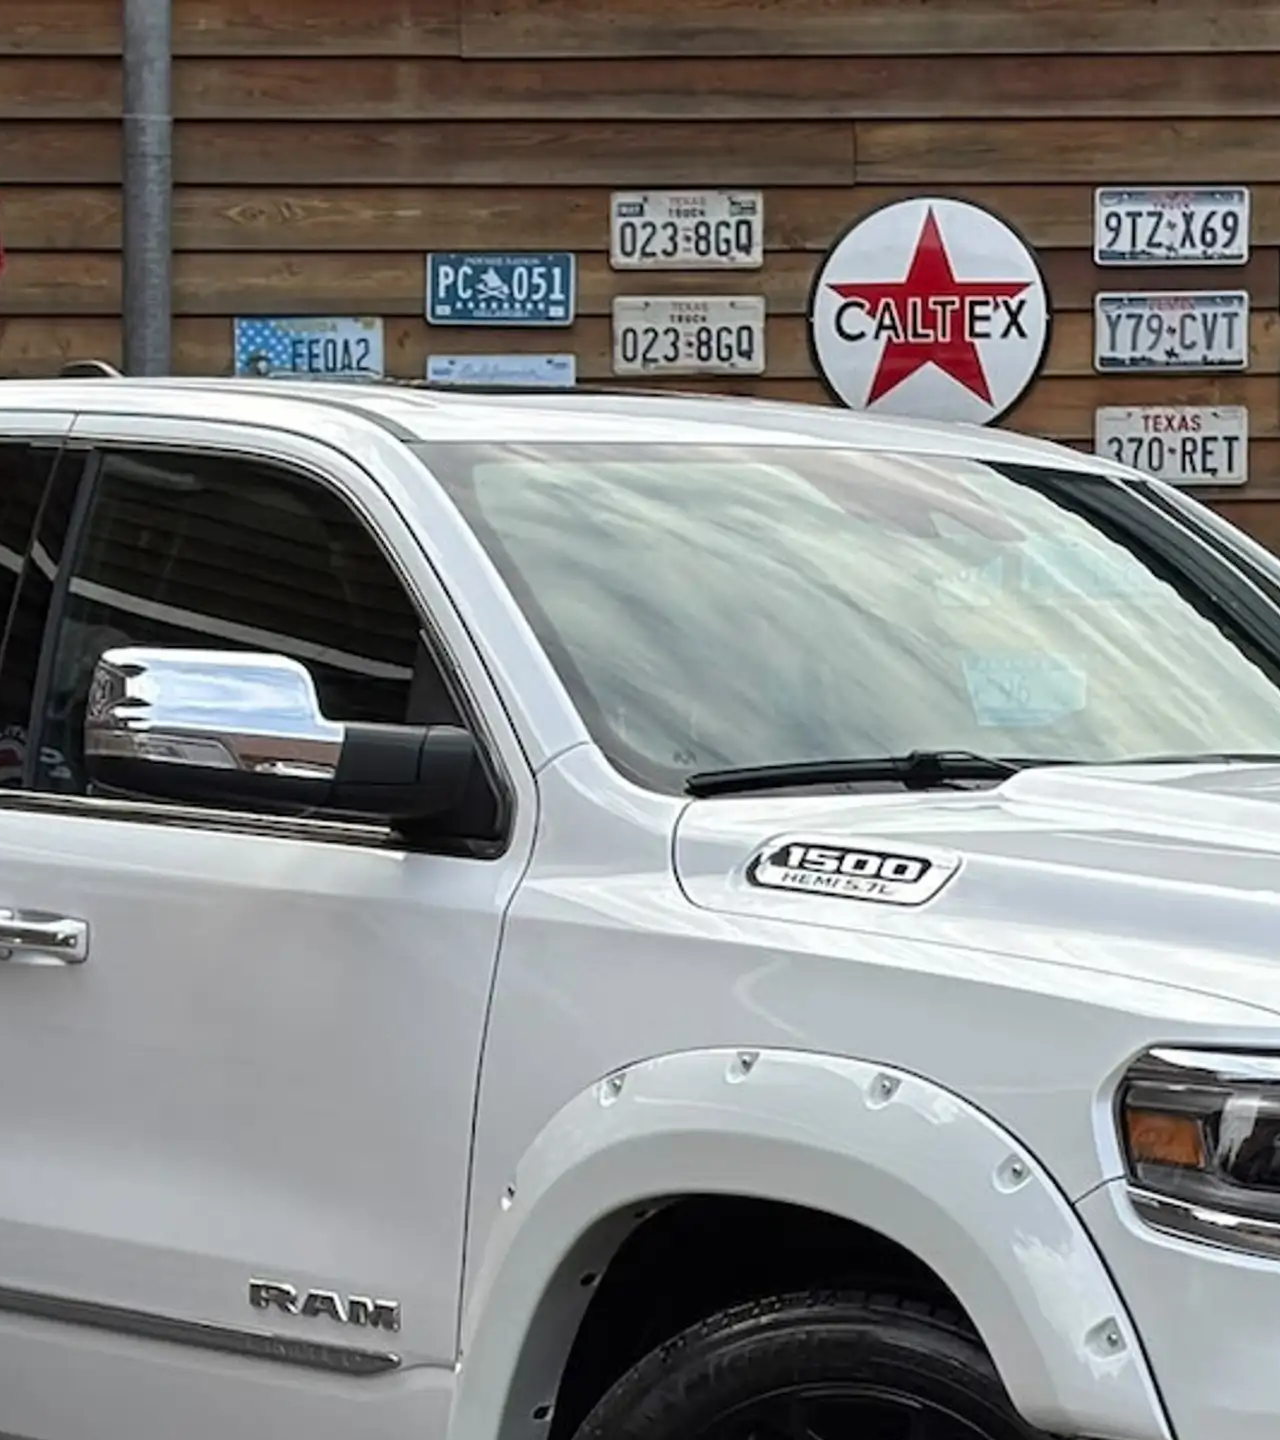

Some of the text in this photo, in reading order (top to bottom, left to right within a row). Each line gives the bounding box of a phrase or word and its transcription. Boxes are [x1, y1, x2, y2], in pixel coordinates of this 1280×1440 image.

[833, 300, 1028, 342] CALTEX
[1142, 414, 1202, 433] TEXAS
[787, 845, 923, 883] 1500
[249, 1278, 402, 1333] RAM
